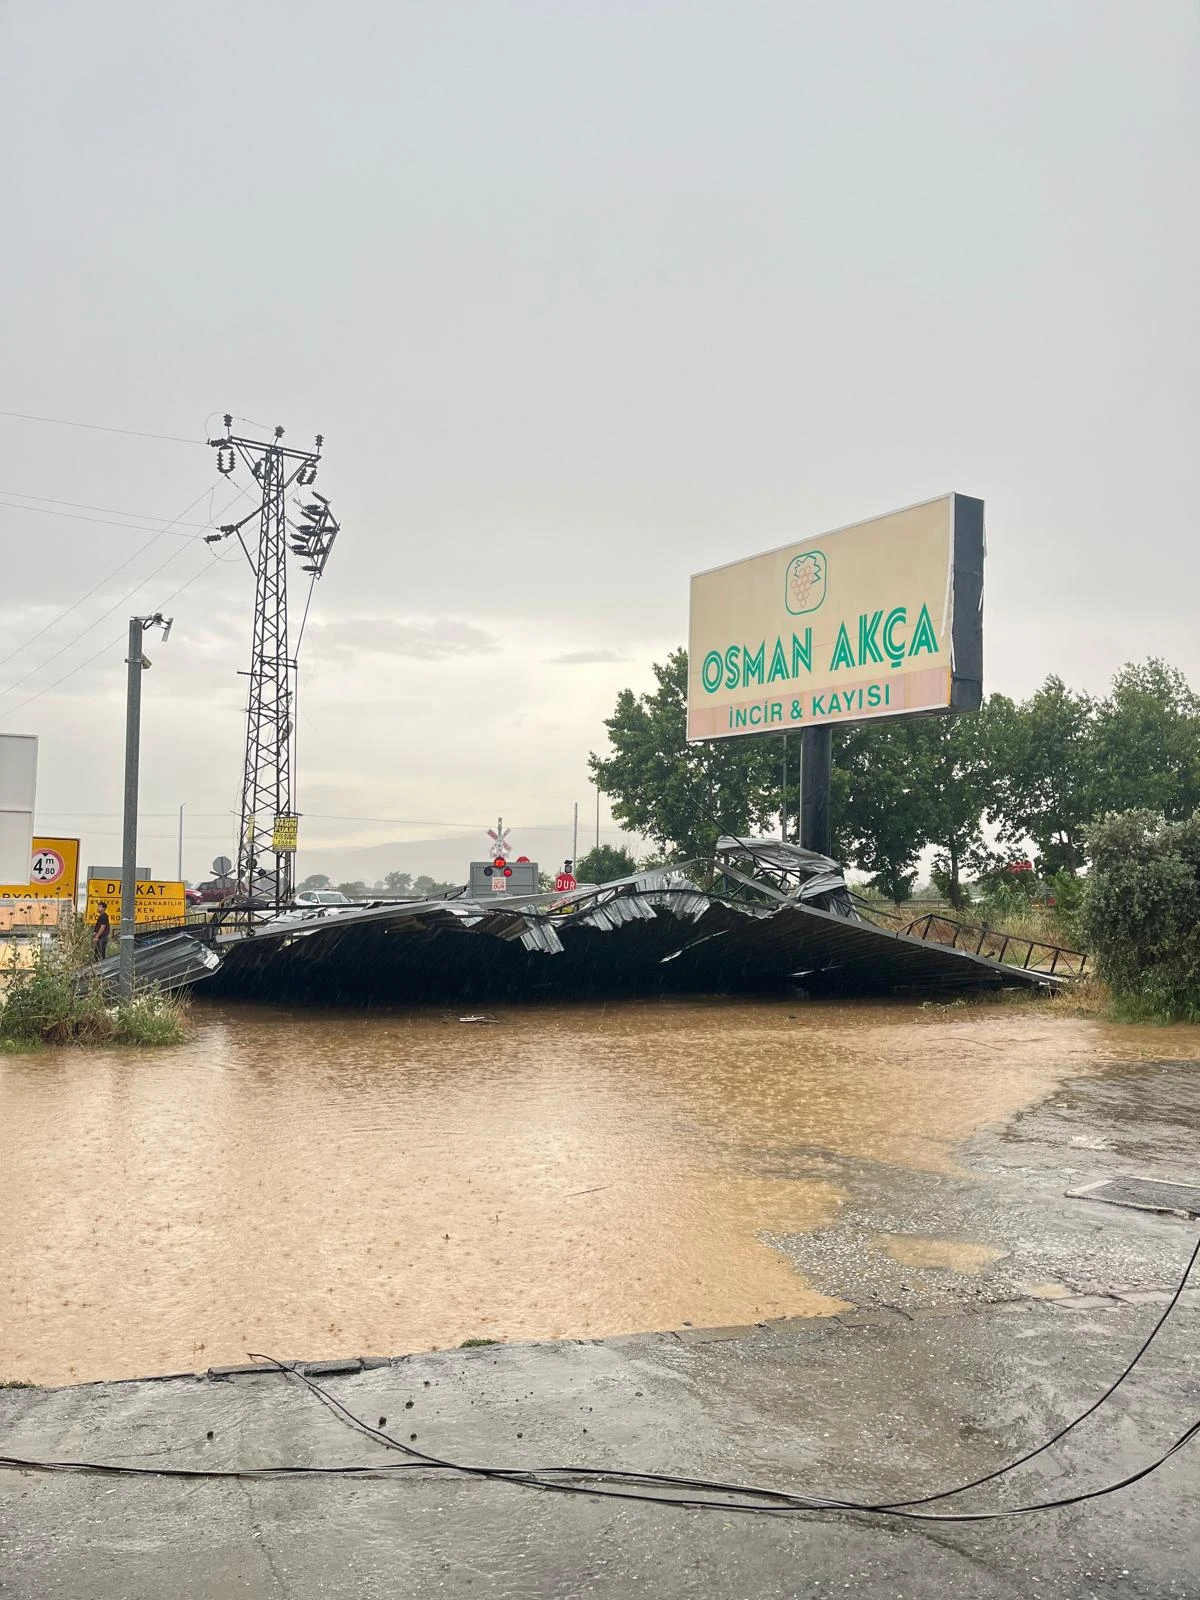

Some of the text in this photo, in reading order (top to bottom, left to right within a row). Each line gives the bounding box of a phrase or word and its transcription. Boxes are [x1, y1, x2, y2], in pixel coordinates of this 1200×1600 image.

[702, 601, 939, 694] OSMAN AKÇA
[729, 683, 890, 728] İNCİR & KAYISI
[33, 858, 43, 874] 4
[107, 882, 166, 895] DİKAT
[557, 879, 576, 891] DUR
